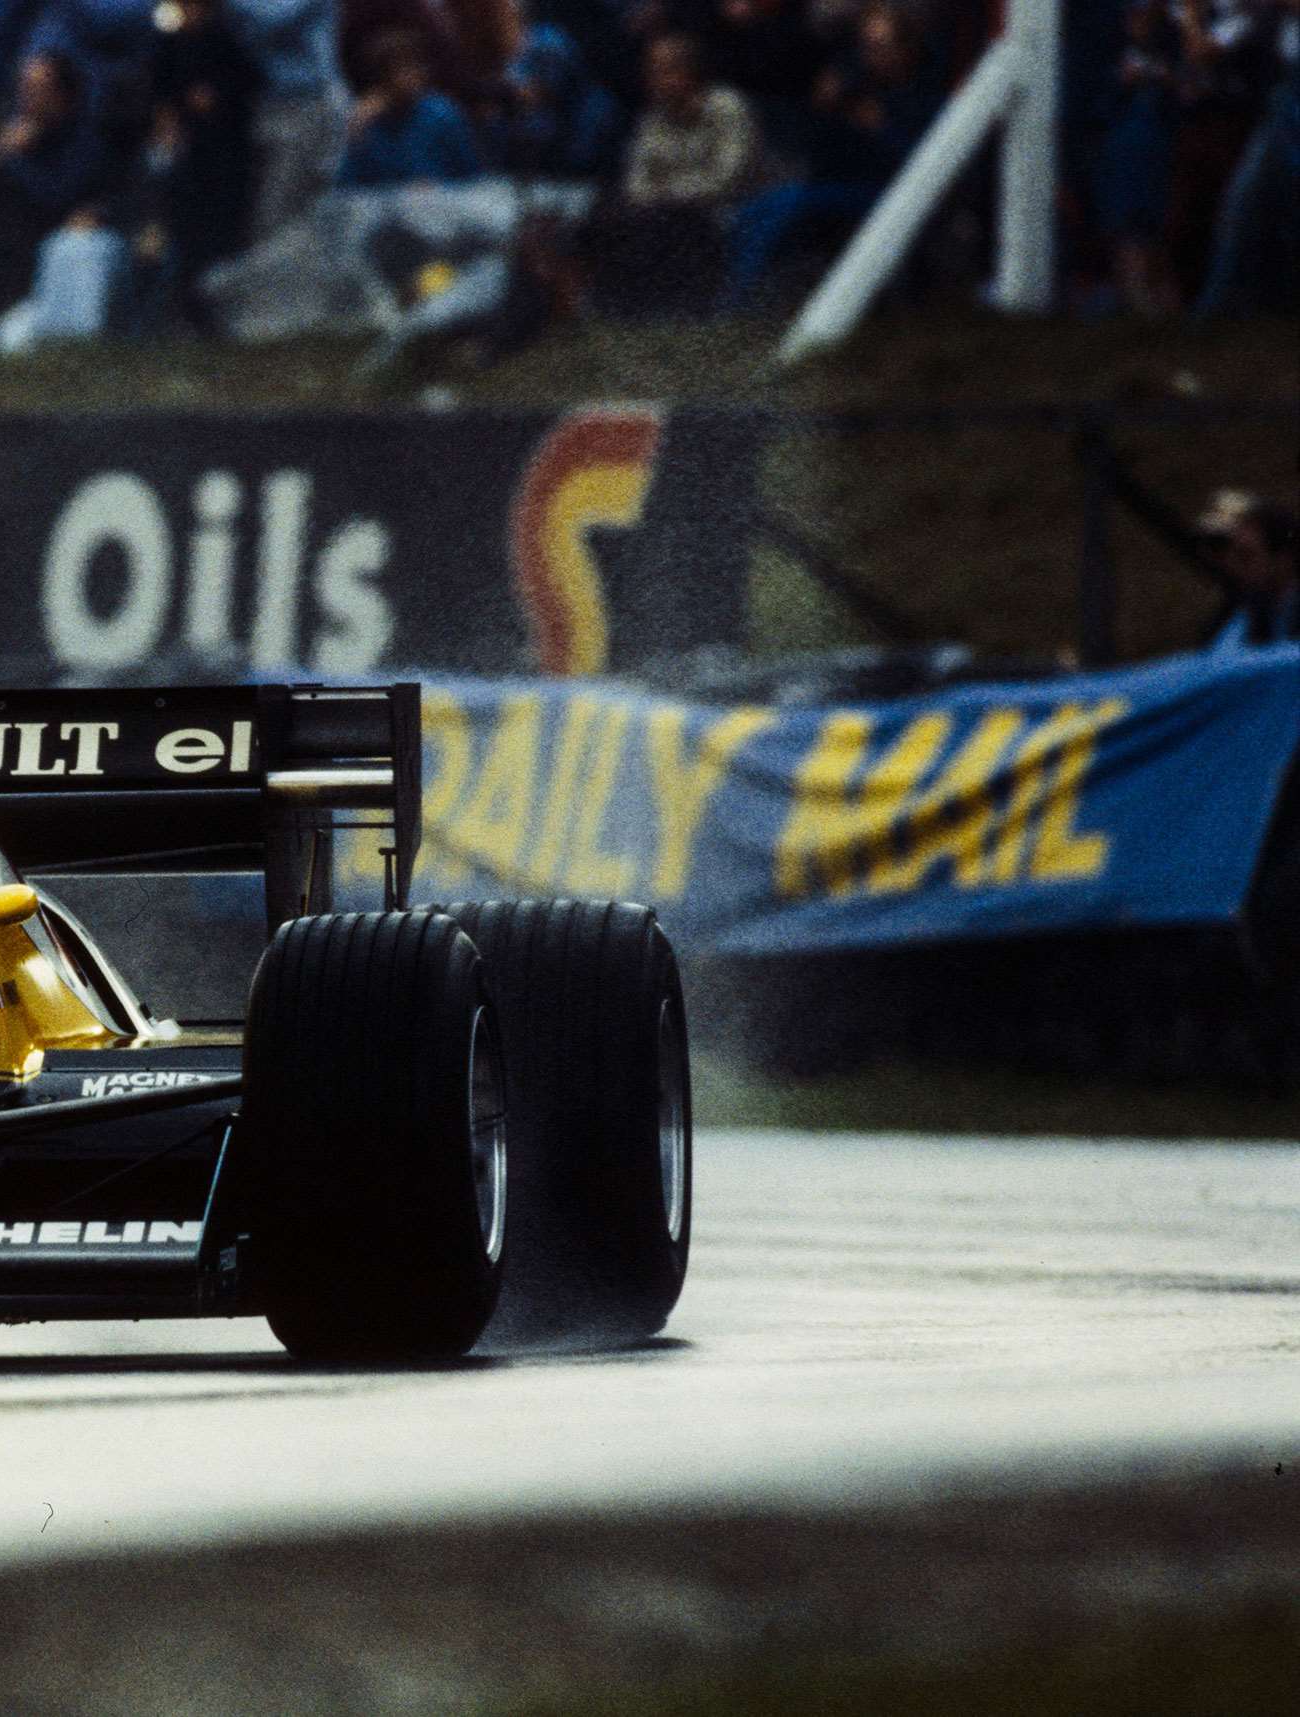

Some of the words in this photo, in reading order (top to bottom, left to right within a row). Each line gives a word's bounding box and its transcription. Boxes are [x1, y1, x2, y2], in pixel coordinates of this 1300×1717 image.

[41, 470, 397, 676] Oils
[154, 720, 258, 774] el
[773, 698, 1128, 897] MAIL
